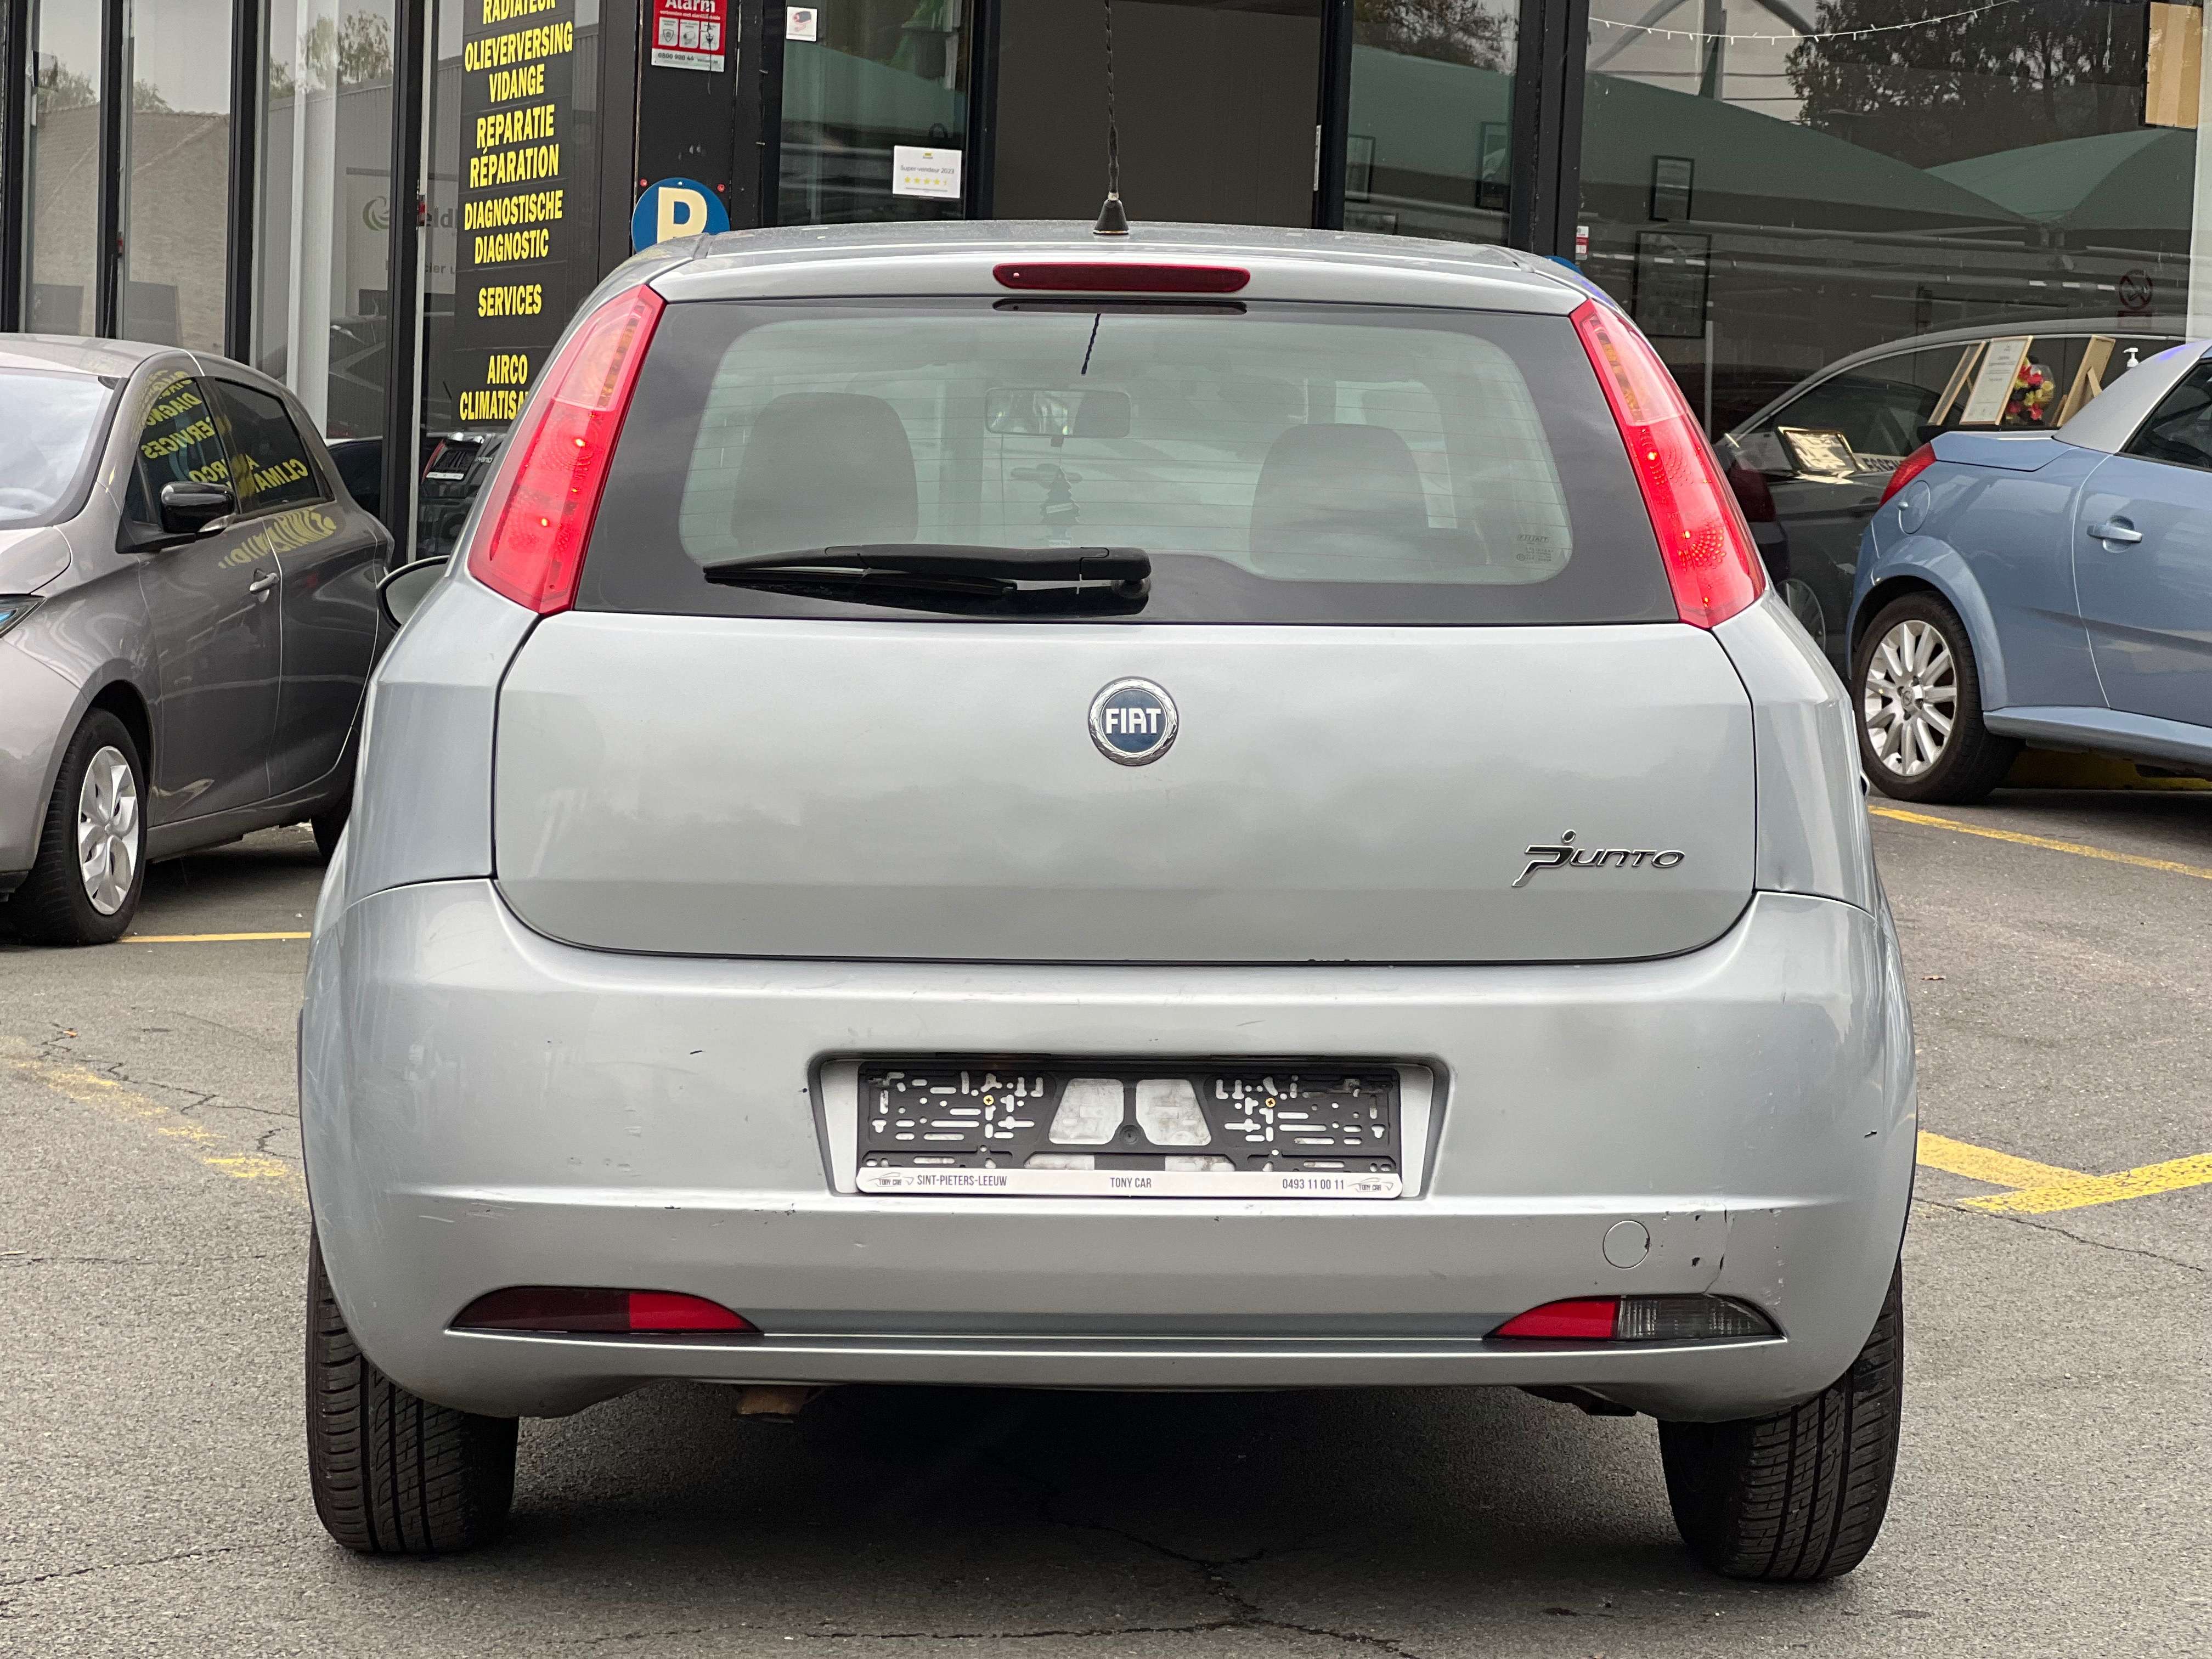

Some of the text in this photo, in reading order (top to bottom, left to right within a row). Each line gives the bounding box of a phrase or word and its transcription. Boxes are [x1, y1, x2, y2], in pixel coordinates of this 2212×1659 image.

[483, 0, 556, 25] RADIA
[465, 21, 573, 72] OLIEVERVERSING
[489, 63, 545, 103] VIDANGE
[476, 104, 555, 149] REPARATIE
[470, 144, 559, 189] RÉPARATION
[900, 165, 940, 173] Super-vendeur
[464, 189, 563, 230] DIAGNOSTISCHE
[657, 187, 708, 244] P
[475, 228, 549, 264] DIAGNOSTIC
[478, 284, 542, 317] SERVICES
[487, 354, 528, 384] AIRCO
[460, 390, 529, 420] CLIMATISA
[1105, 708, 1161, 734] FIAT
[917, 1175, 1007, 1186] SINT-PIETERS-LEEUW
[1110, 1177, 1152, 1188] TONY CAR
[1282, 1178, 1344, 1189] 0493 11 00 11
